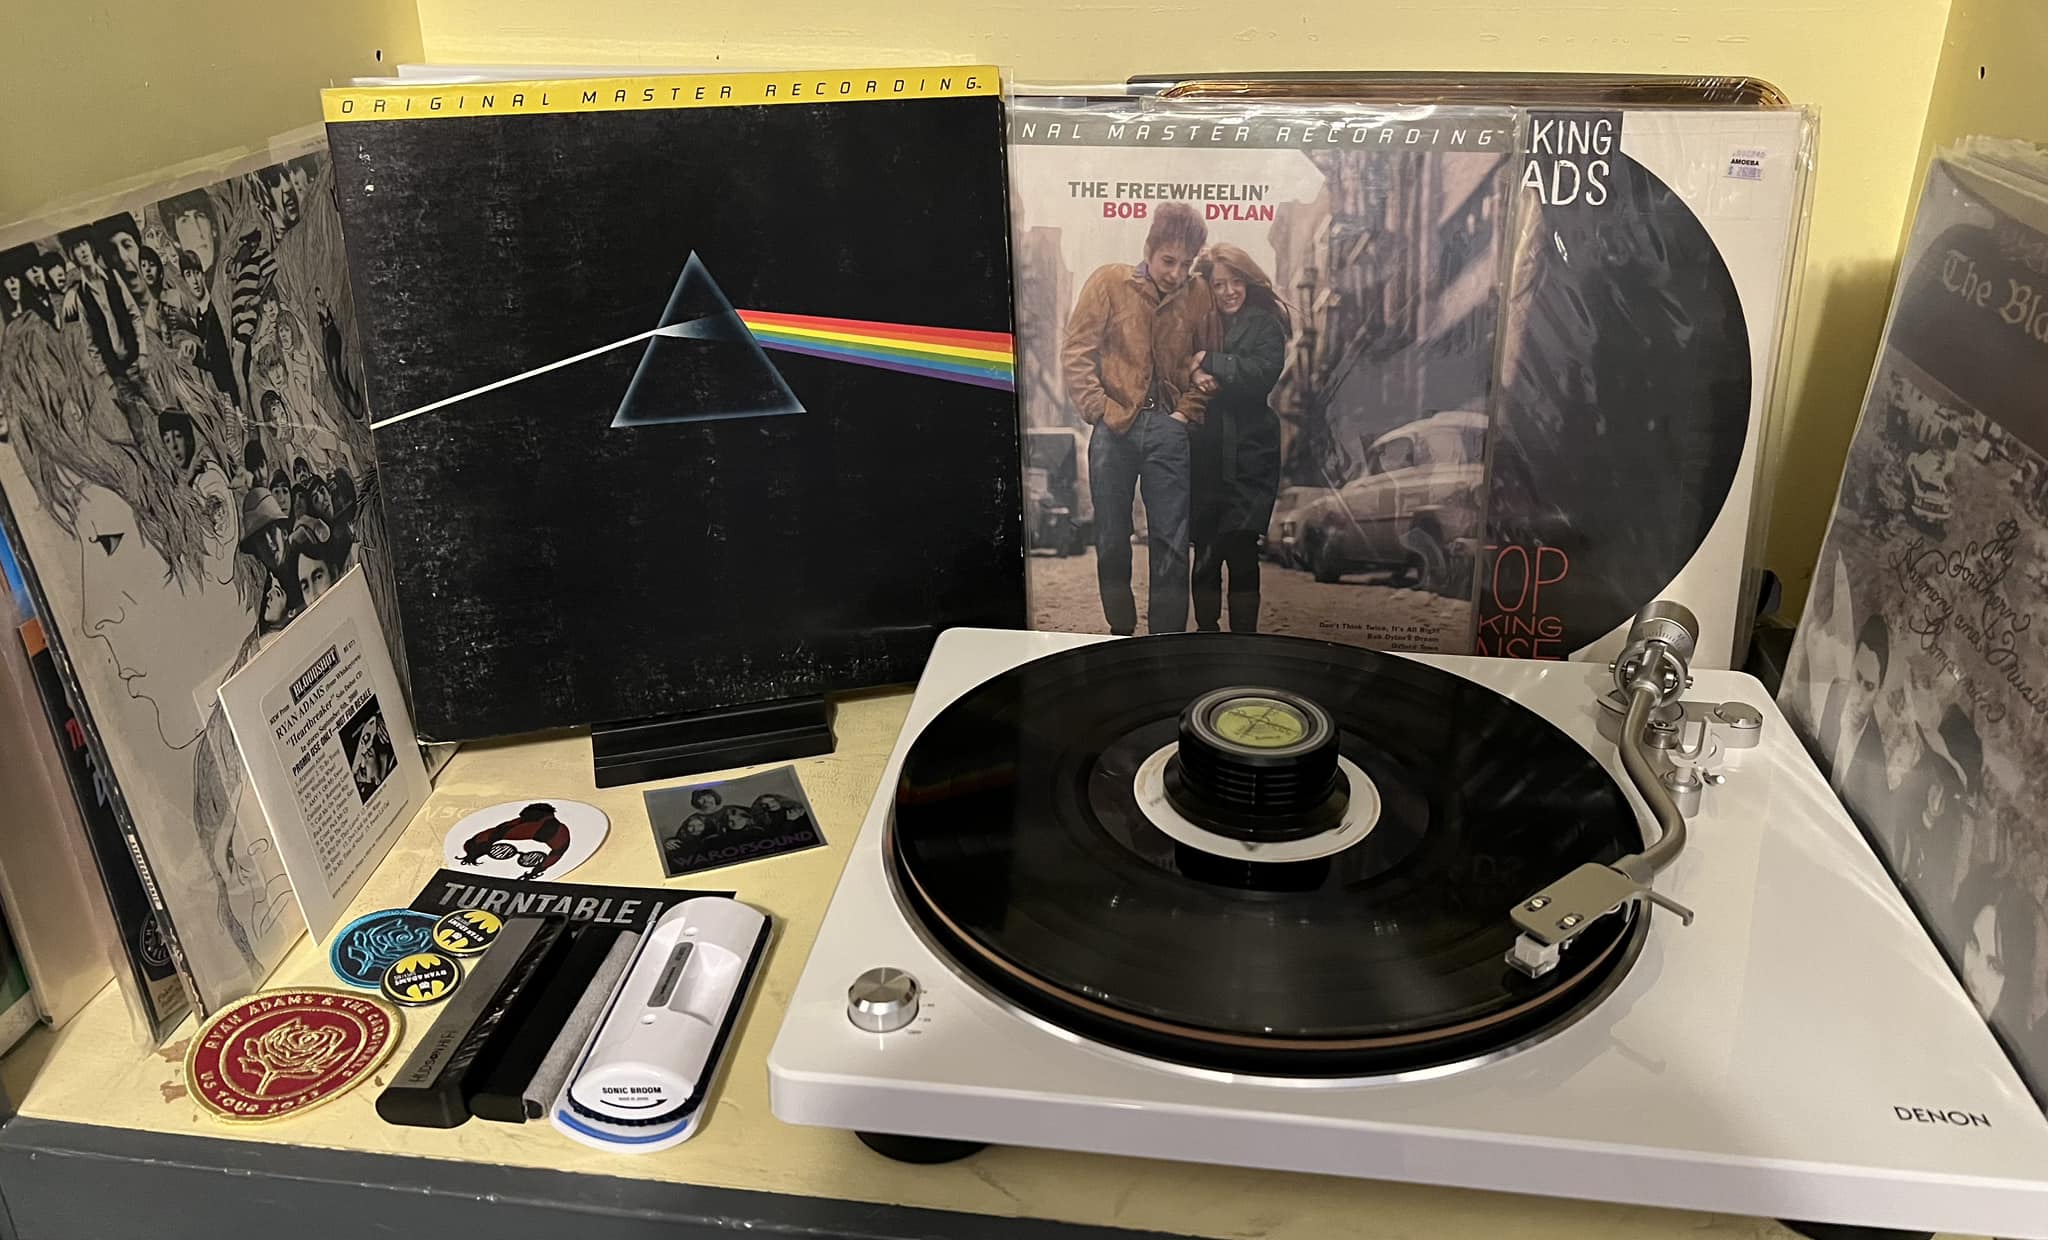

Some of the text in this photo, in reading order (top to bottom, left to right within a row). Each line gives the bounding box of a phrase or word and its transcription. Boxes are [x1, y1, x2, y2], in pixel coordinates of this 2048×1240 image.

[342, 93, 550, 114] ORIGINAL
[582, 85, 732, 104] MASTER
[1006, 122, 1061, 139] INAL
[1107, 124, 1250, 142] MASTER
[1526, 119, 1612, 155] KING
[1521, 160, 1610, 206] ADS
[1730, 158, 1760, 166] AMOEBA
[1068, 181, 1109, 198] THE
[1103, 202, 1275, 221] BOB DYLAN
[1943, 249, 2048, 344] The Bla
[1484, 545, 1568, 615] OP
[1479, 614, 1562, 638] KING
[293, 648, 336, 697] BLOODSHOT
[275, 711, 298, 740] RYAN
[296, 683, 325, 718] ADAMS
[292, 751, 311, 777] PROMO
[310, 740, 321, 757] USE
[344, 704, 355, 720] FOR
[354, 686, 372, 710] RESALE
[439, 882, 642, 924] TURNTABLE
[205, 1015, 243, 1049] RYAN
[249, 995, 314, 1017] ADAMS
[201, 1071, 217, 1089] US
[216, 1090, 260, 1113] TOUR
[1894, 1106, 1992, 1127] DENON
